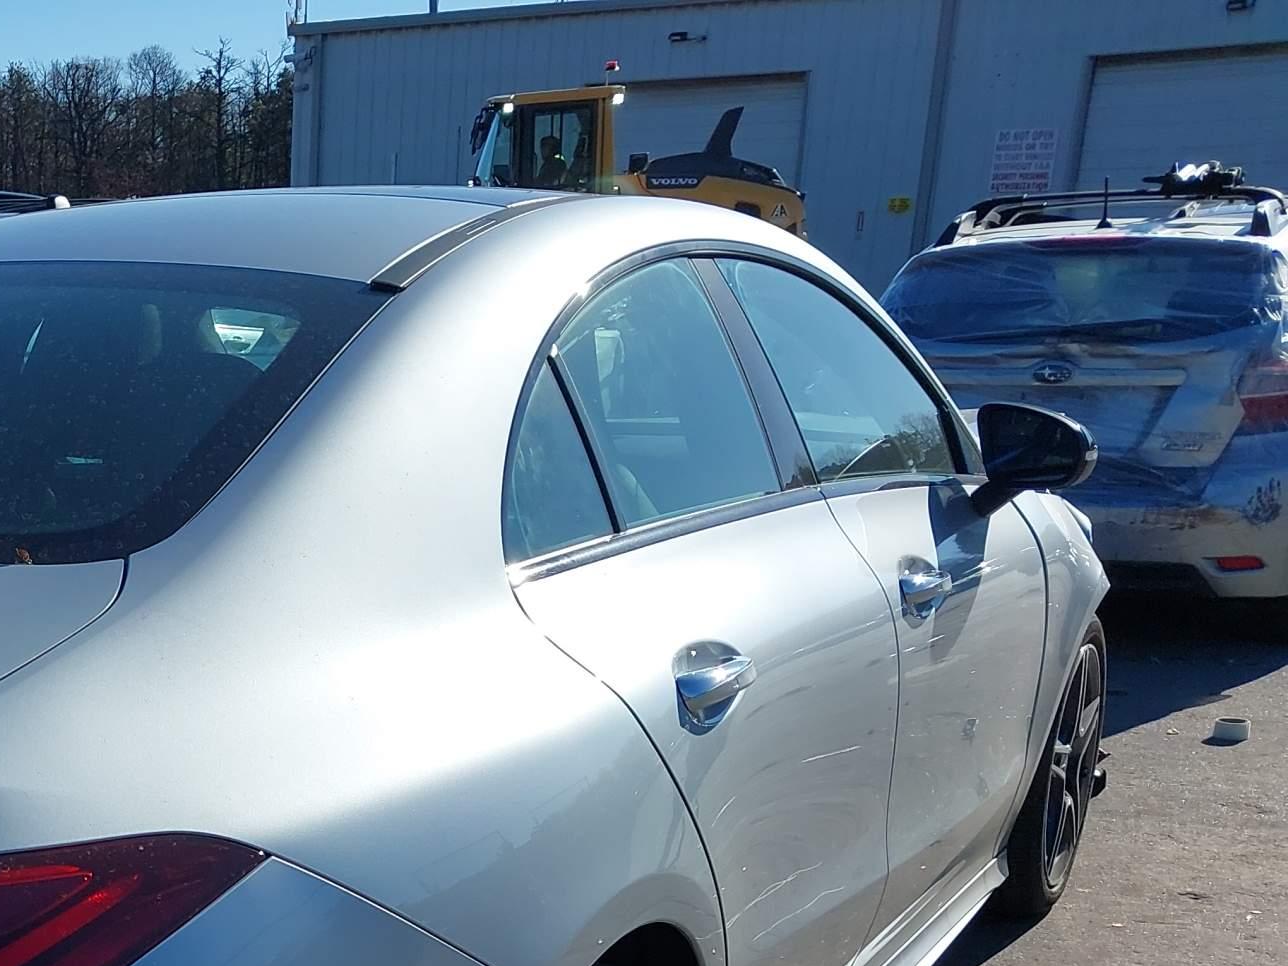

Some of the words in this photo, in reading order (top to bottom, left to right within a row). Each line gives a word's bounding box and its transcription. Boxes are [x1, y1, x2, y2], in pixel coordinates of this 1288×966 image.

[998, 130, 1011, 142] DO
[1013, 130, 1031, 141] NOT
[1031, 129, 1054, 141] OPEN
[650, 177, 698, 186] VOLVO
